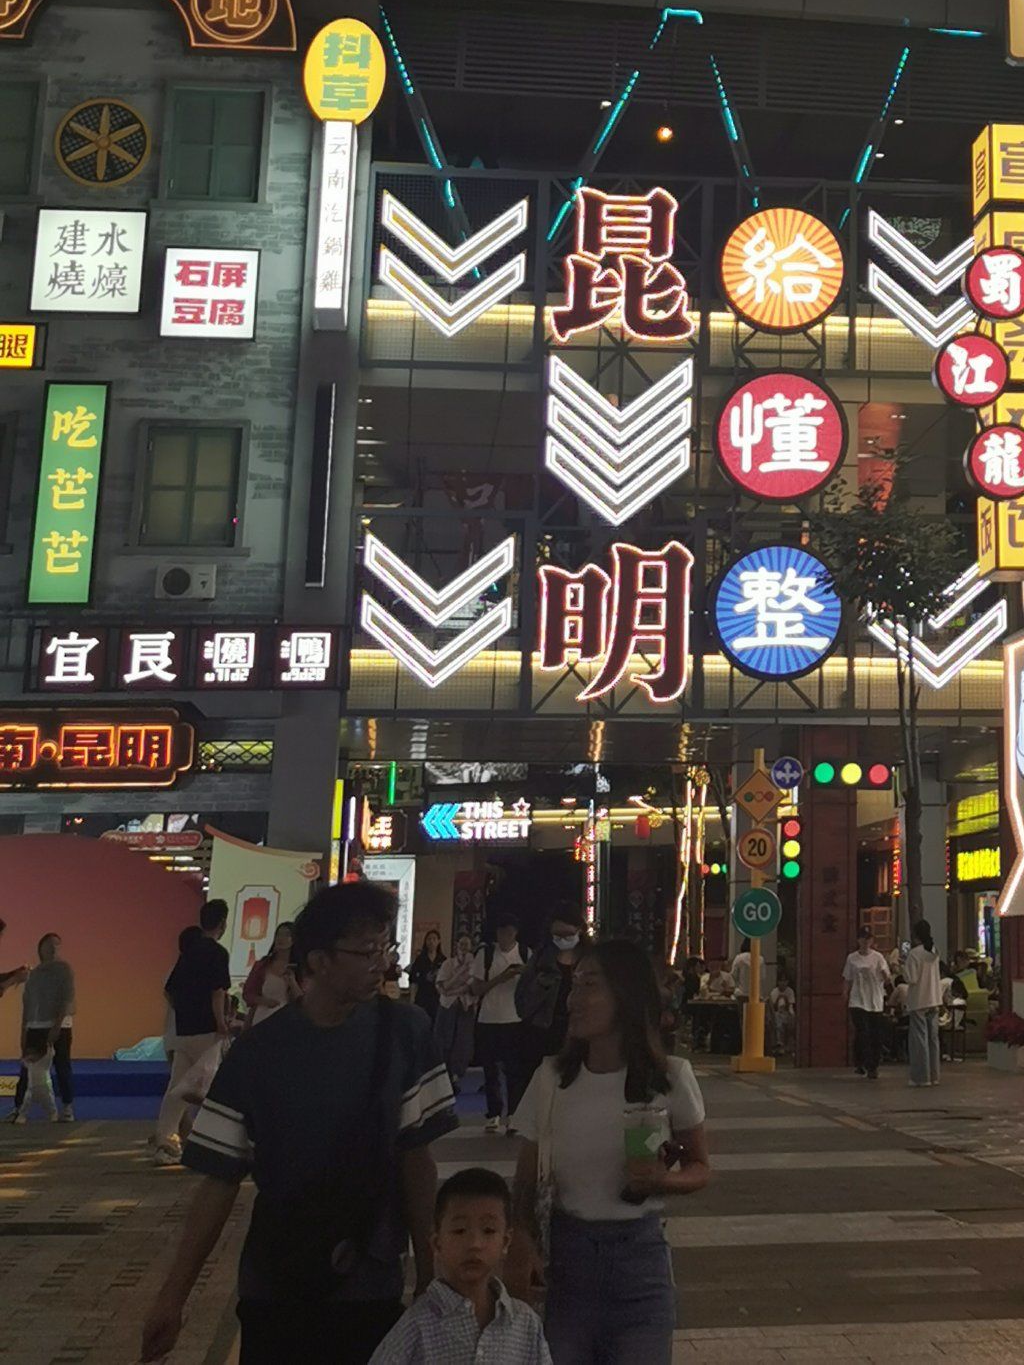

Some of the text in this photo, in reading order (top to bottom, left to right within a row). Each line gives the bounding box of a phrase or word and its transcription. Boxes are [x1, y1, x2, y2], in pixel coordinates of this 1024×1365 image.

[50, 219, 132, 257] 建水
[175, 260, 249, 288] 石屏
[172, 298, 246, 326] 豆腐
[42, 406, 98, 574] 吃芒芒
[463, 801, 504, 819] THIS
[461, 821, 532, 839] STREET
[748, 838, 767, 856] 20
[743, 902, 771, 921] GO
